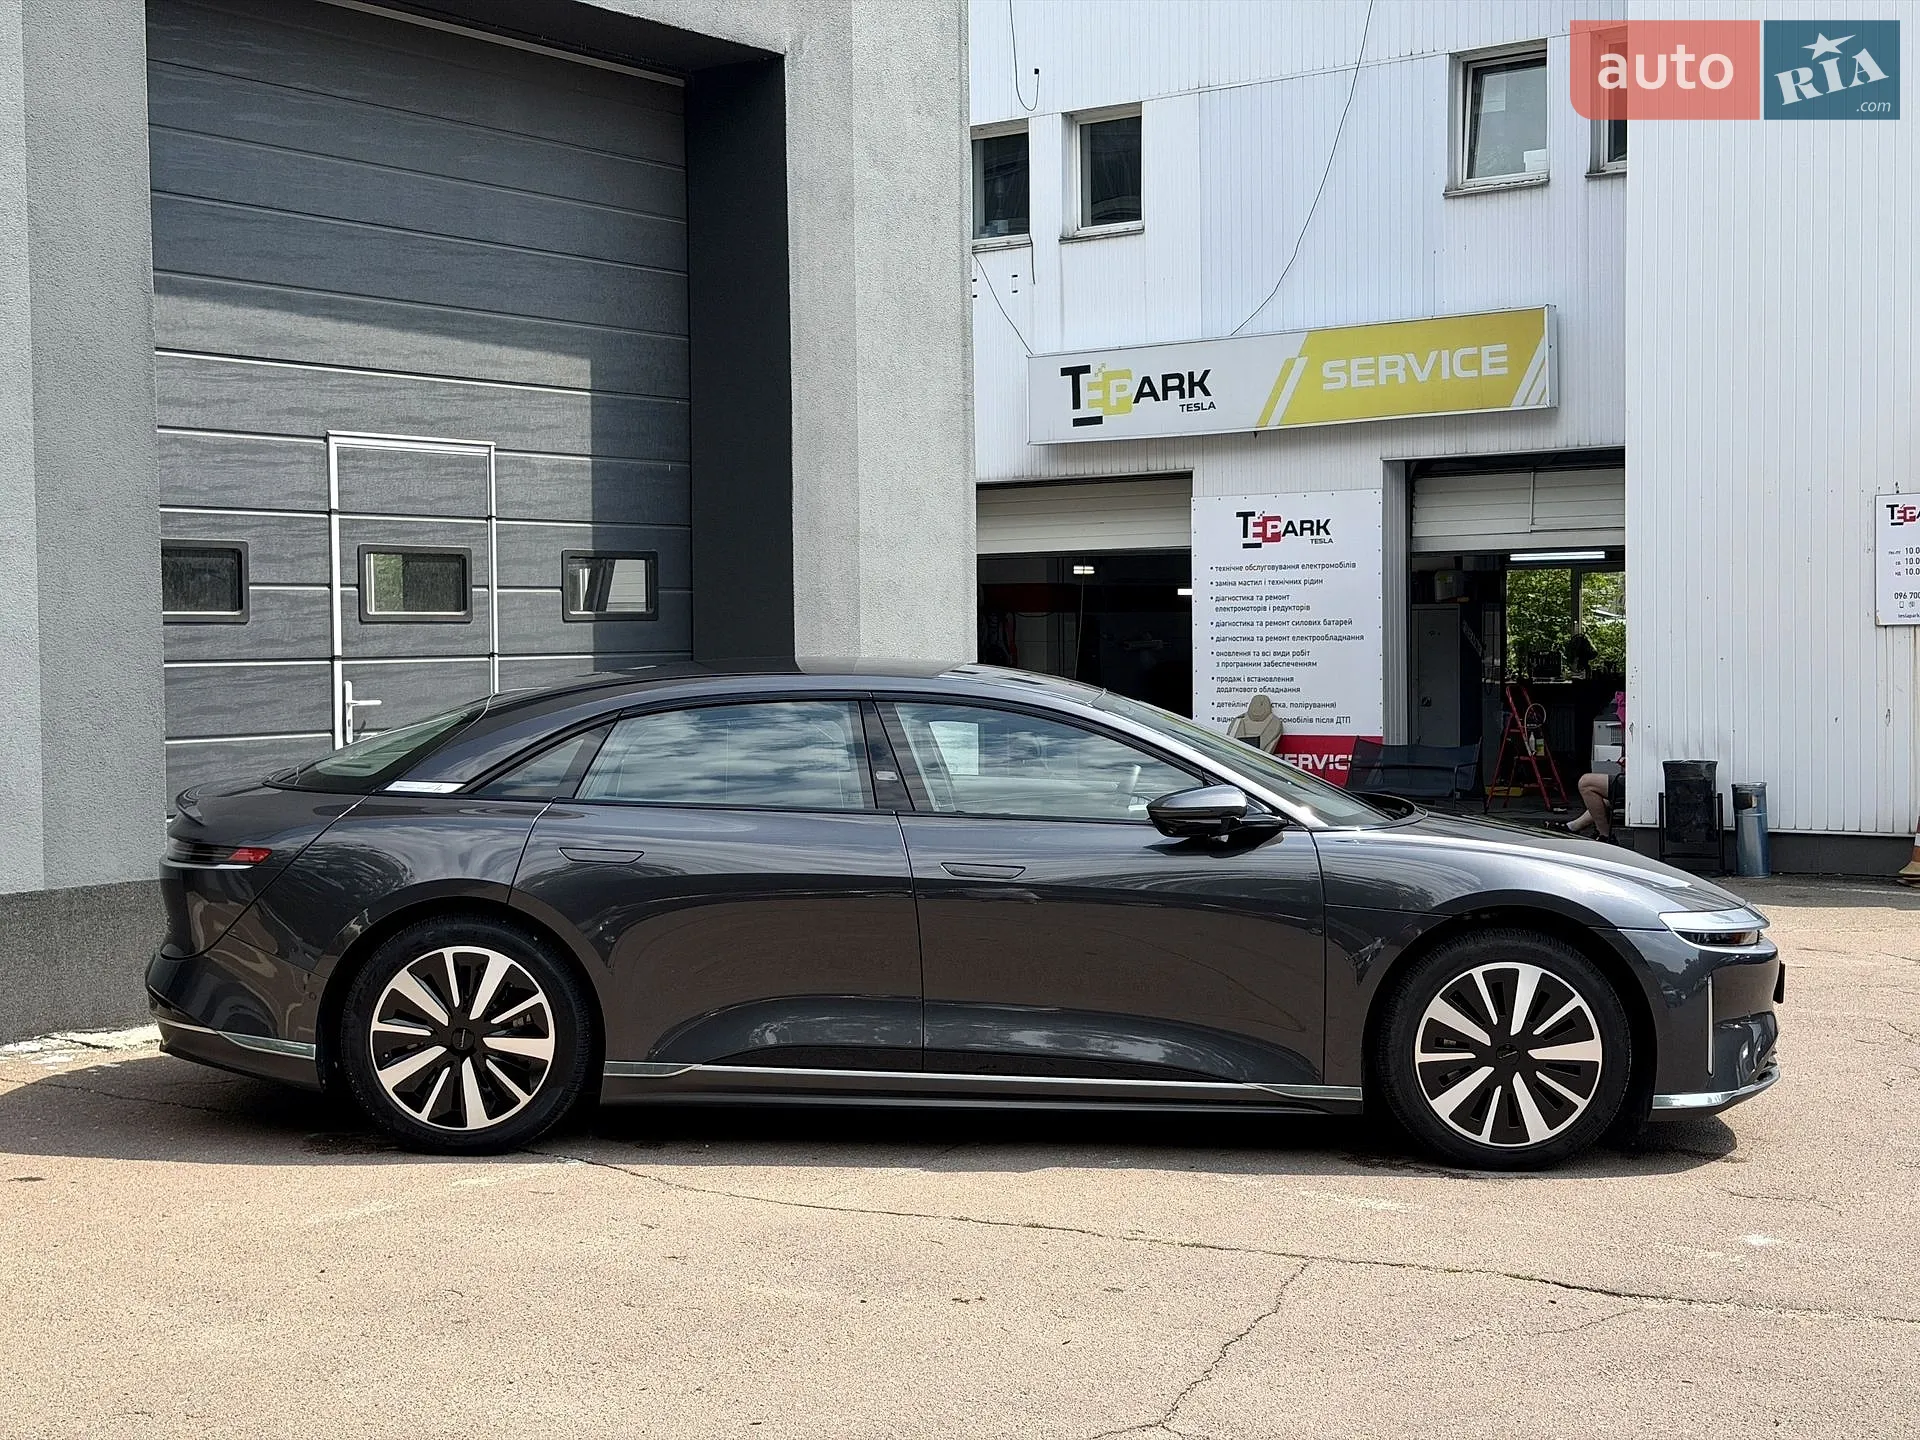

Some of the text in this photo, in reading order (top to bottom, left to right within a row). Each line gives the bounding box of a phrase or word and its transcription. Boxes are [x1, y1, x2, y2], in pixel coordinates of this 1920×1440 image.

[1322, 343, 1509, 391] SERVICE
[1179, 401, 1217, 413] TESLA
[1885, 504, 1920, 526] TEP
[1244, 563, 1300, 573] обслуговування
[1301, 561, 1357, 571] електромобілів
[1265, 594, 1290, 602] ремонт
[1894, 591, 1908, 600] 096
[1265, 620, 1290, 628] ремонт
[1322, 617, 1353, 627] батарей
[1265, 635, 1290, 643] ремонт
[1335, 715, 1351, 725] ДТП
[1275, 753, 1353, 770] ERVIC
